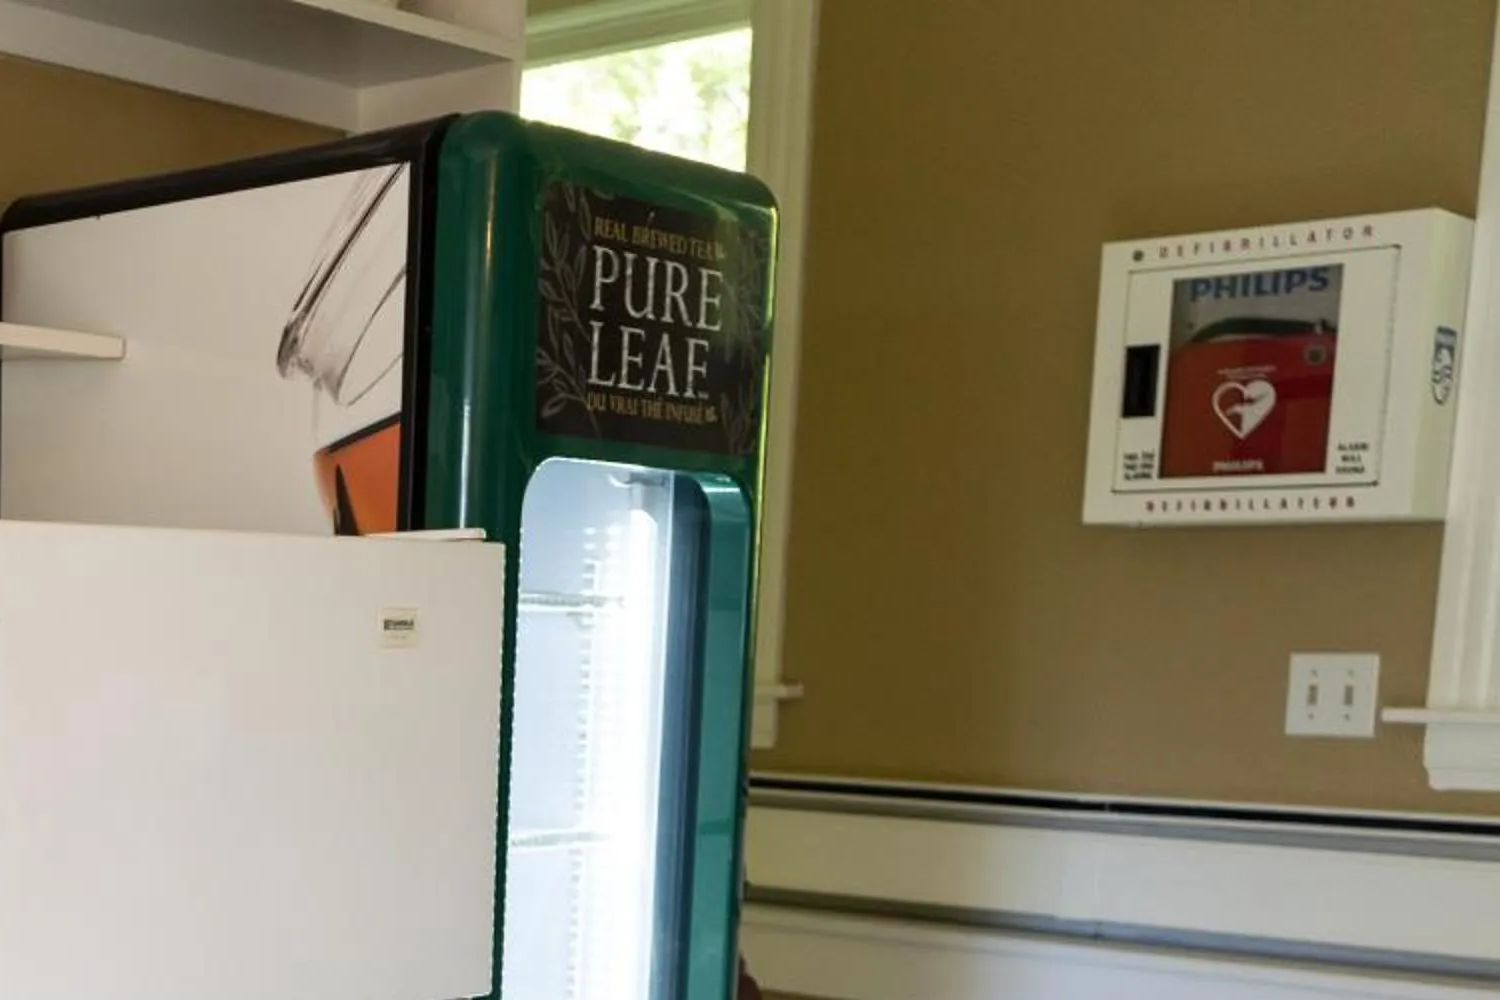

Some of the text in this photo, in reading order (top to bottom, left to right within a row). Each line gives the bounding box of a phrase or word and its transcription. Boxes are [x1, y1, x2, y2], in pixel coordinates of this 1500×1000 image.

[593, 216, 628, 242] REAL
[632, 225, 688, 254] BREWED
[1158, 224, 1375, 258] DEFIBRILLATOR
[589, 244, 724, 332] PURE
[1189, 266, 1331, 302] PHILIPS
[587, 320, 711, 399] LEAF
